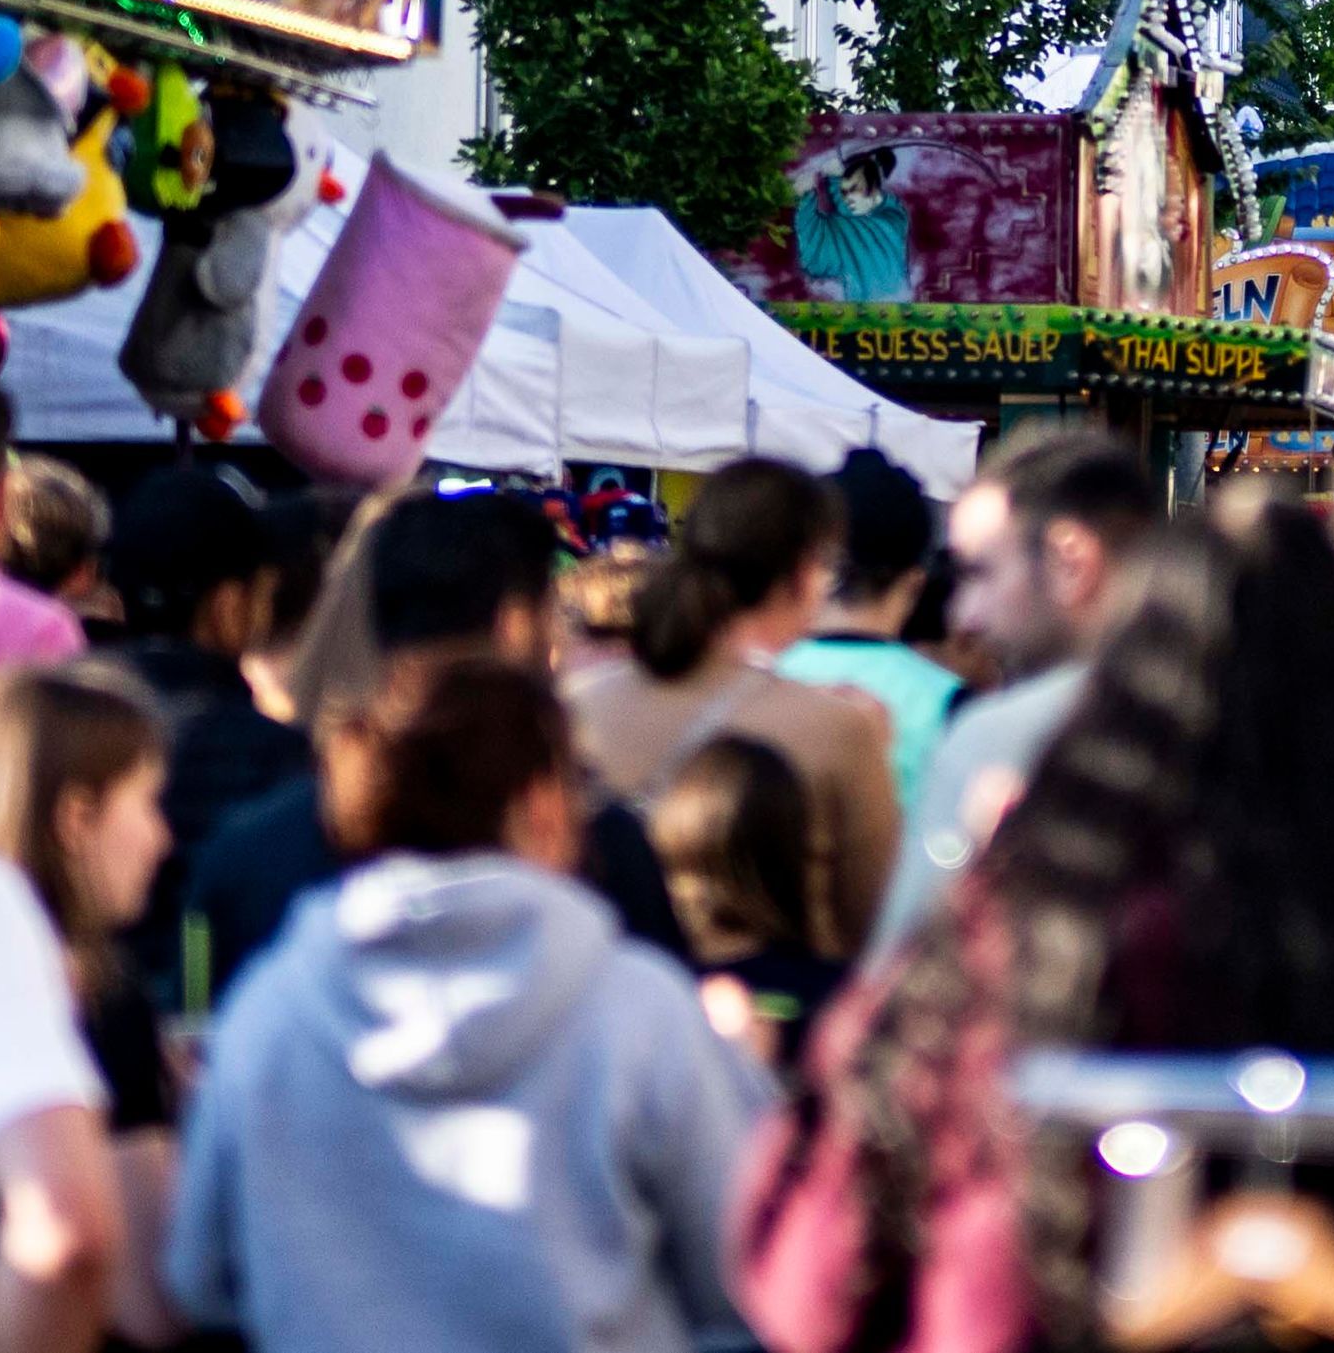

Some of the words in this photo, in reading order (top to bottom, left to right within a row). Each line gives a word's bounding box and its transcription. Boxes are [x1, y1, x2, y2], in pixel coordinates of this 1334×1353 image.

[800, 327, 844, 359] LE
[857, 327, 1061, 362] SUESS-SAUER
[1118, 335, 1178, 373] THAI
[1185, 341, 1267, 381] SUPPE
